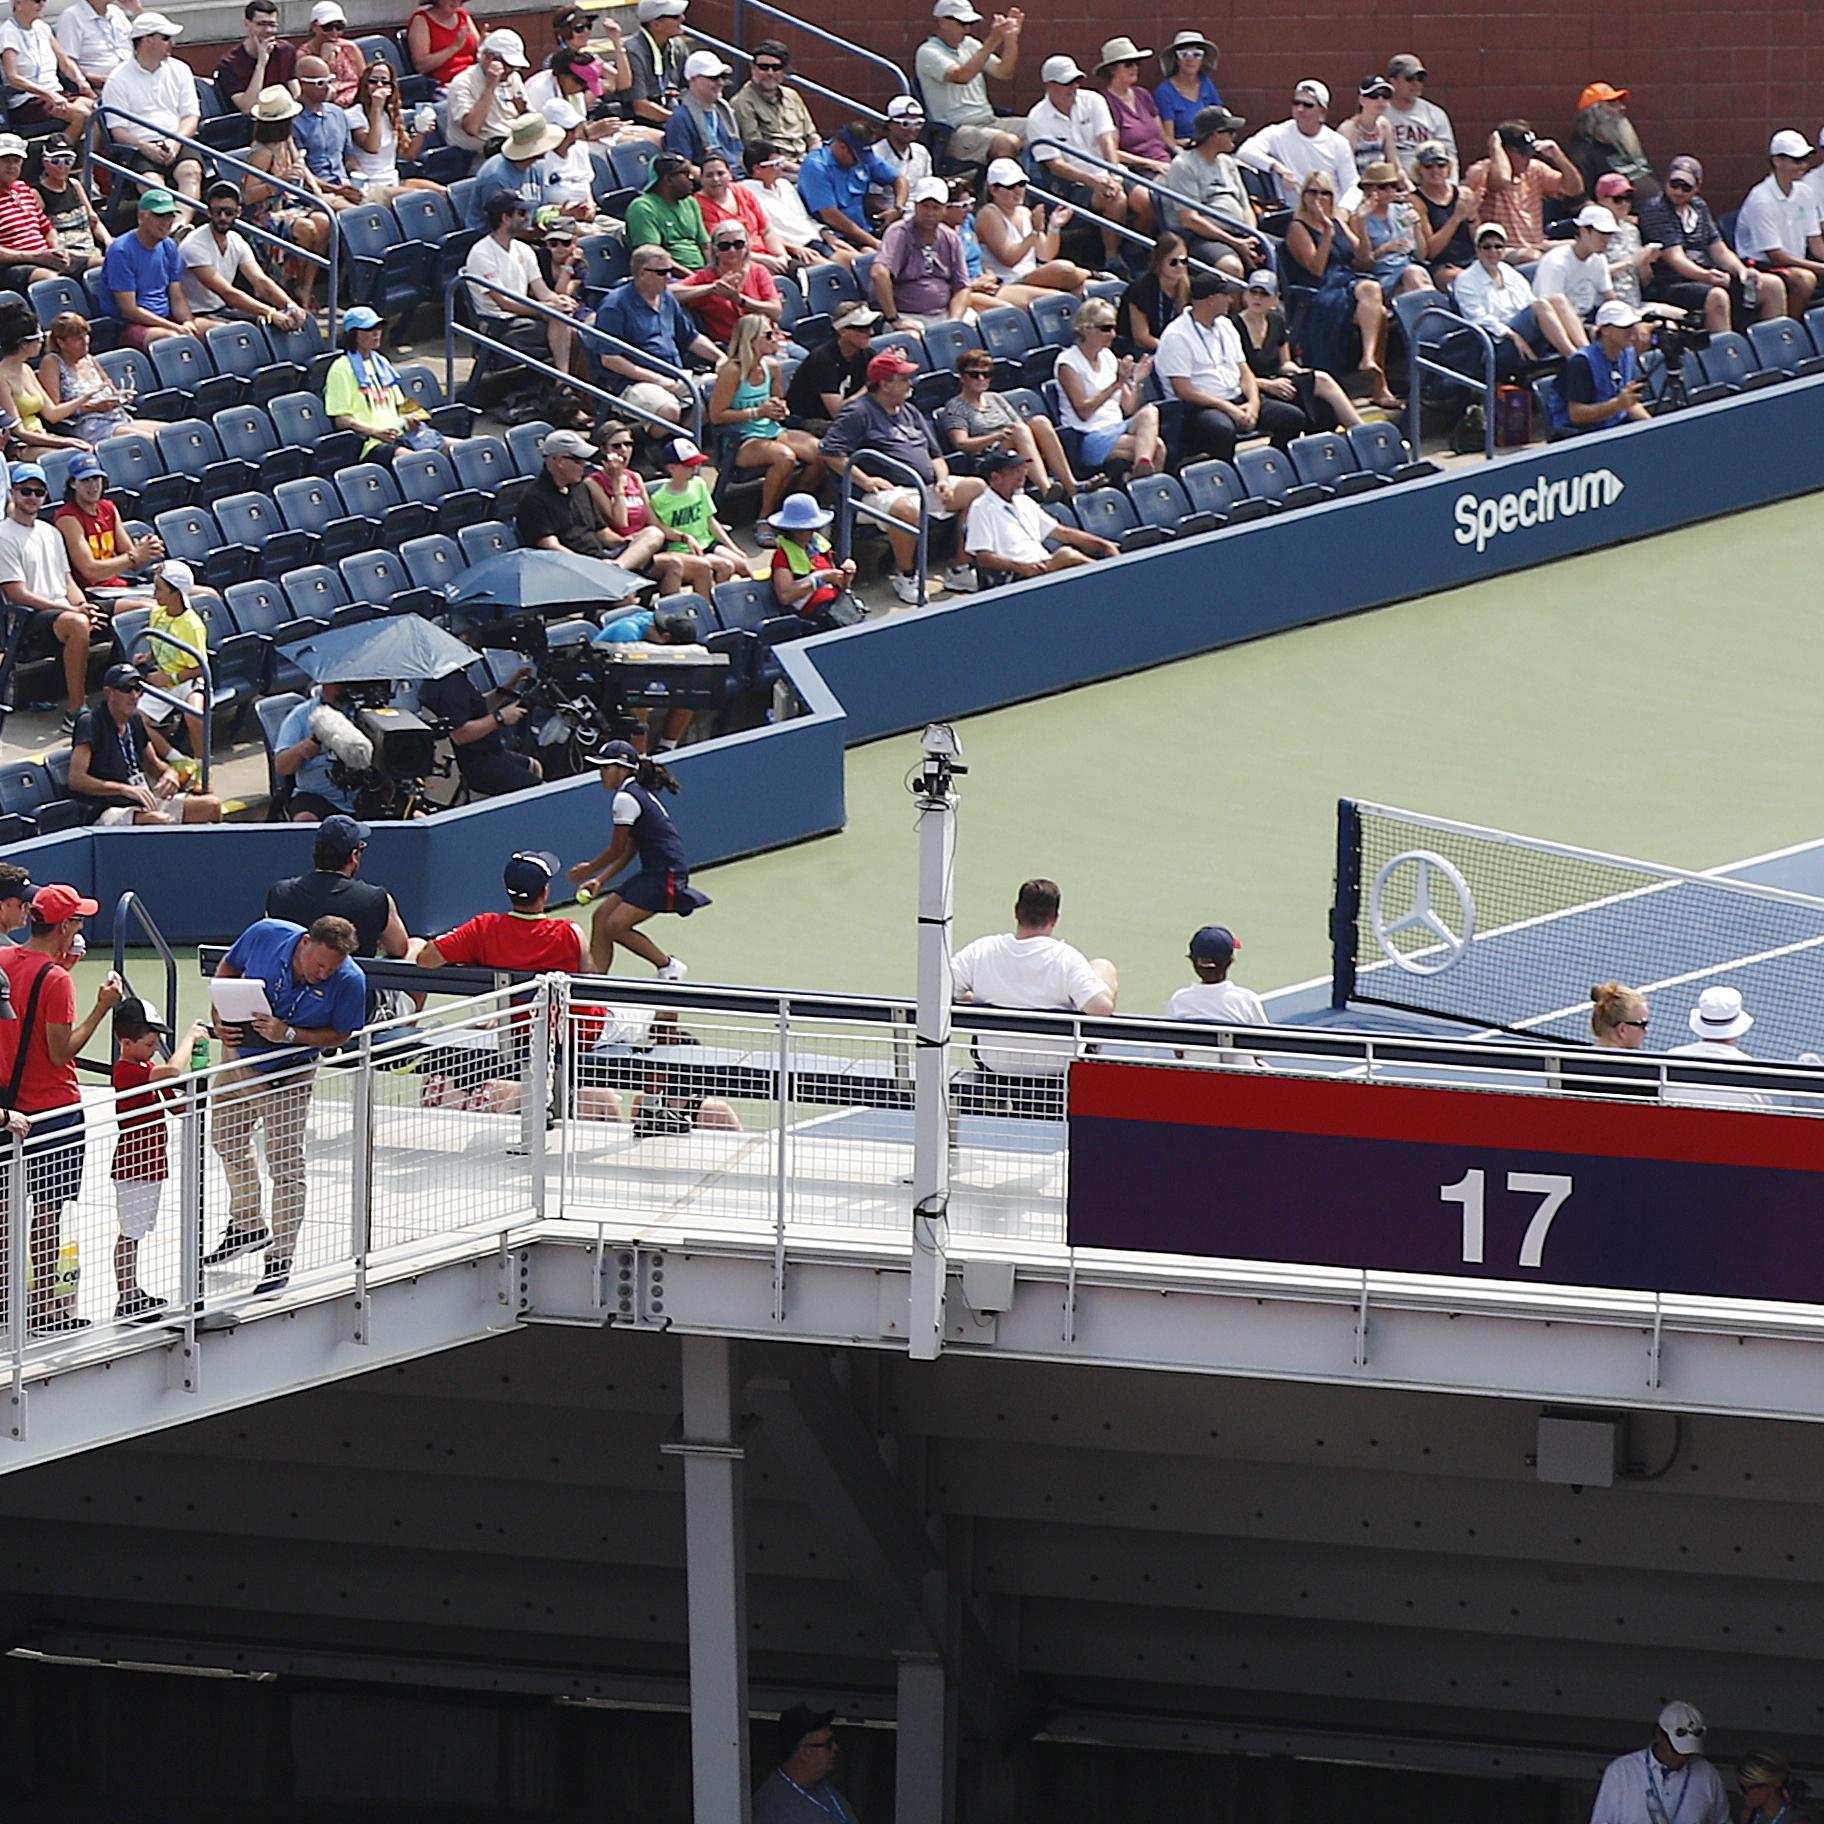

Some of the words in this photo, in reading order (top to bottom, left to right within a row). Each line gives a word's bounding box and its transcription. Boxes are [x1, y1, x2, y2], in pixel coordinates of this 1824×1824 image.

[671, 500, 702, 527] NIKE
[1454, 469, 1624, 553] Spectrum
[1439, 1168, 1574, 1268] 17
